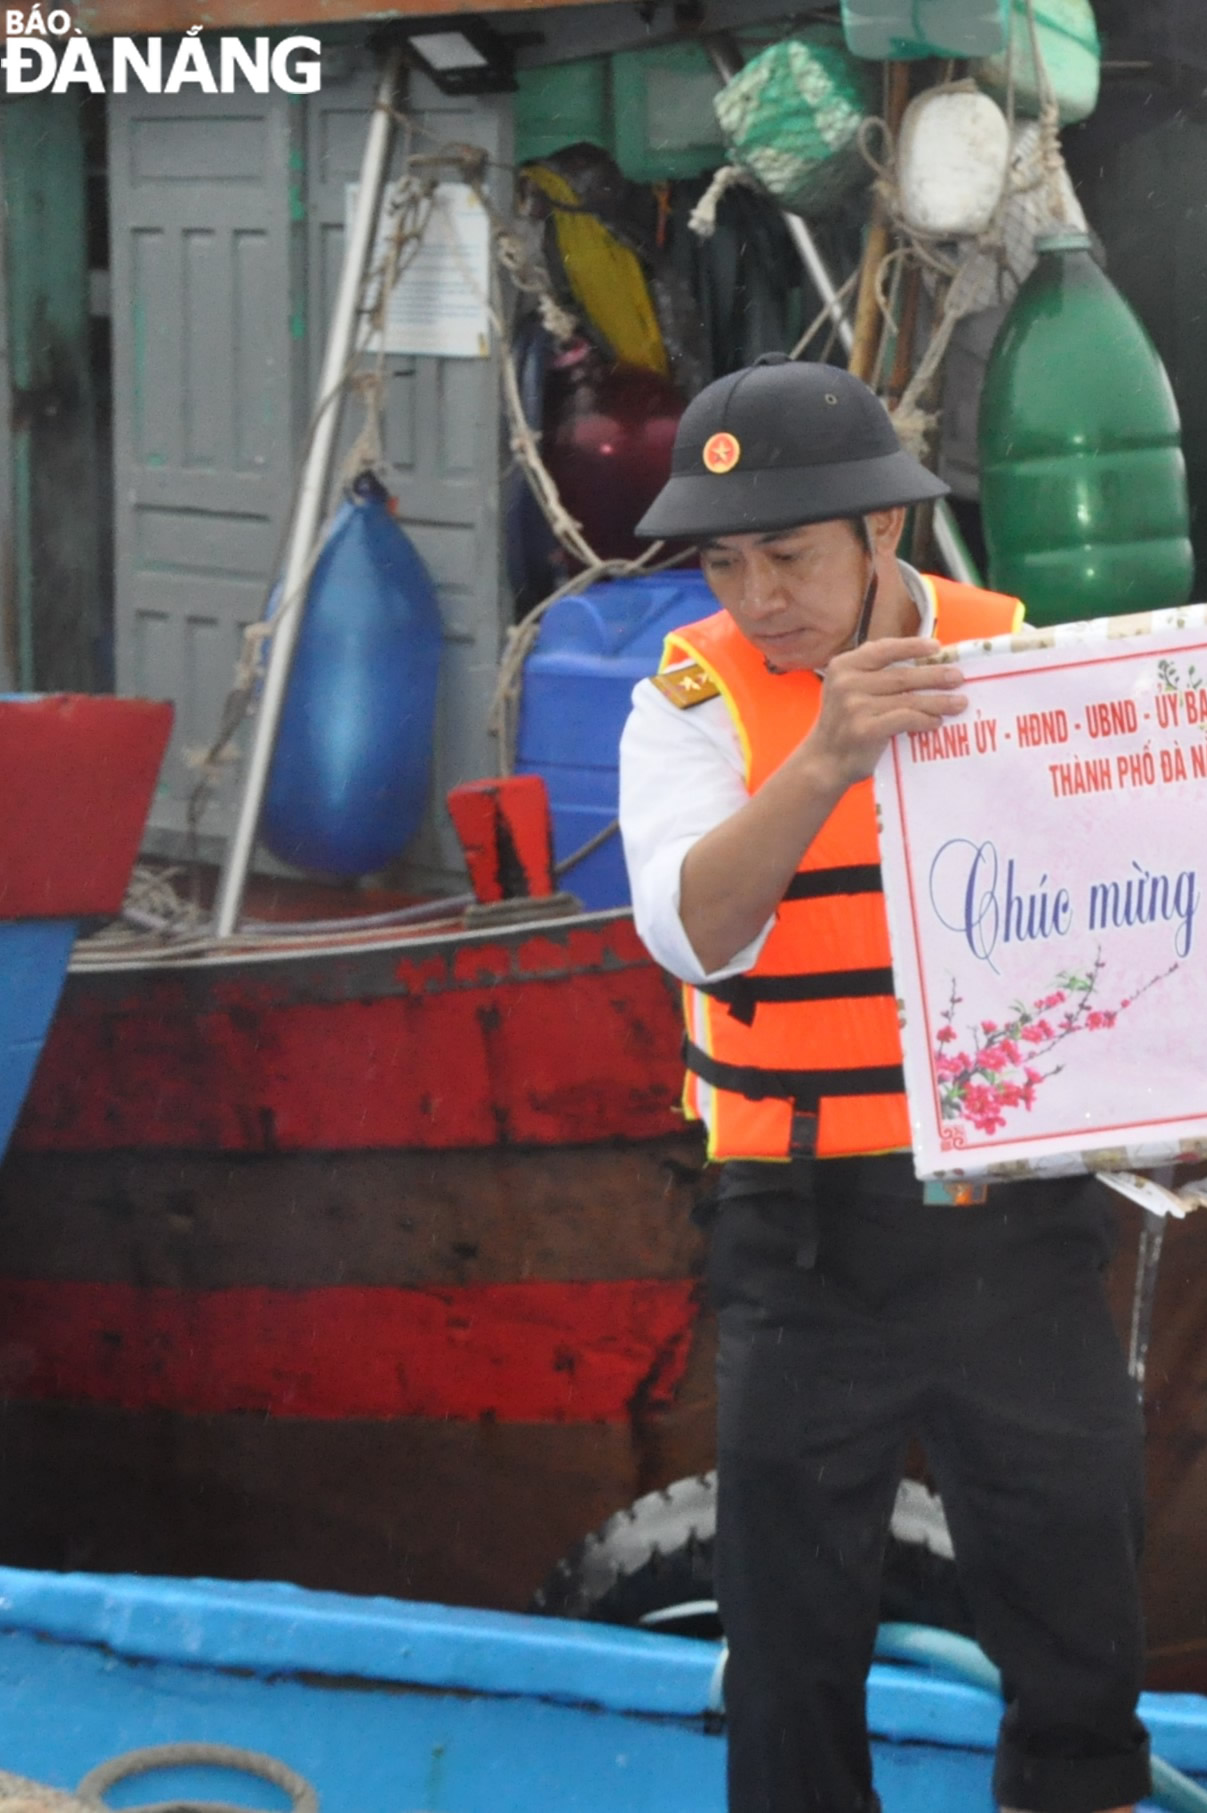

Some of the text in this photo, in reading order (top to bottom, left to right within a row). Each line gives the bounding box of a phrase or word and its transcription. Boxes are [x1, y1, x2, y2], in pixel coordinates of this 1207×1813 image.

[974, 709, 996, 754] ỦY
[1016, 710, 1068, 748] HĐND
[1085, 700, 1137, 738] UBND
[1156, 683, 1178, 728] ỦY
[1049, 754, 1112, 797] THÀNH
[1117, 739, 1155, 788] PHỐ
[1160, 740, 1187, 783] ĐÀ
[929, 838, 1072, 975] Chúc
[1089, 860, 1200, 958] mừng
